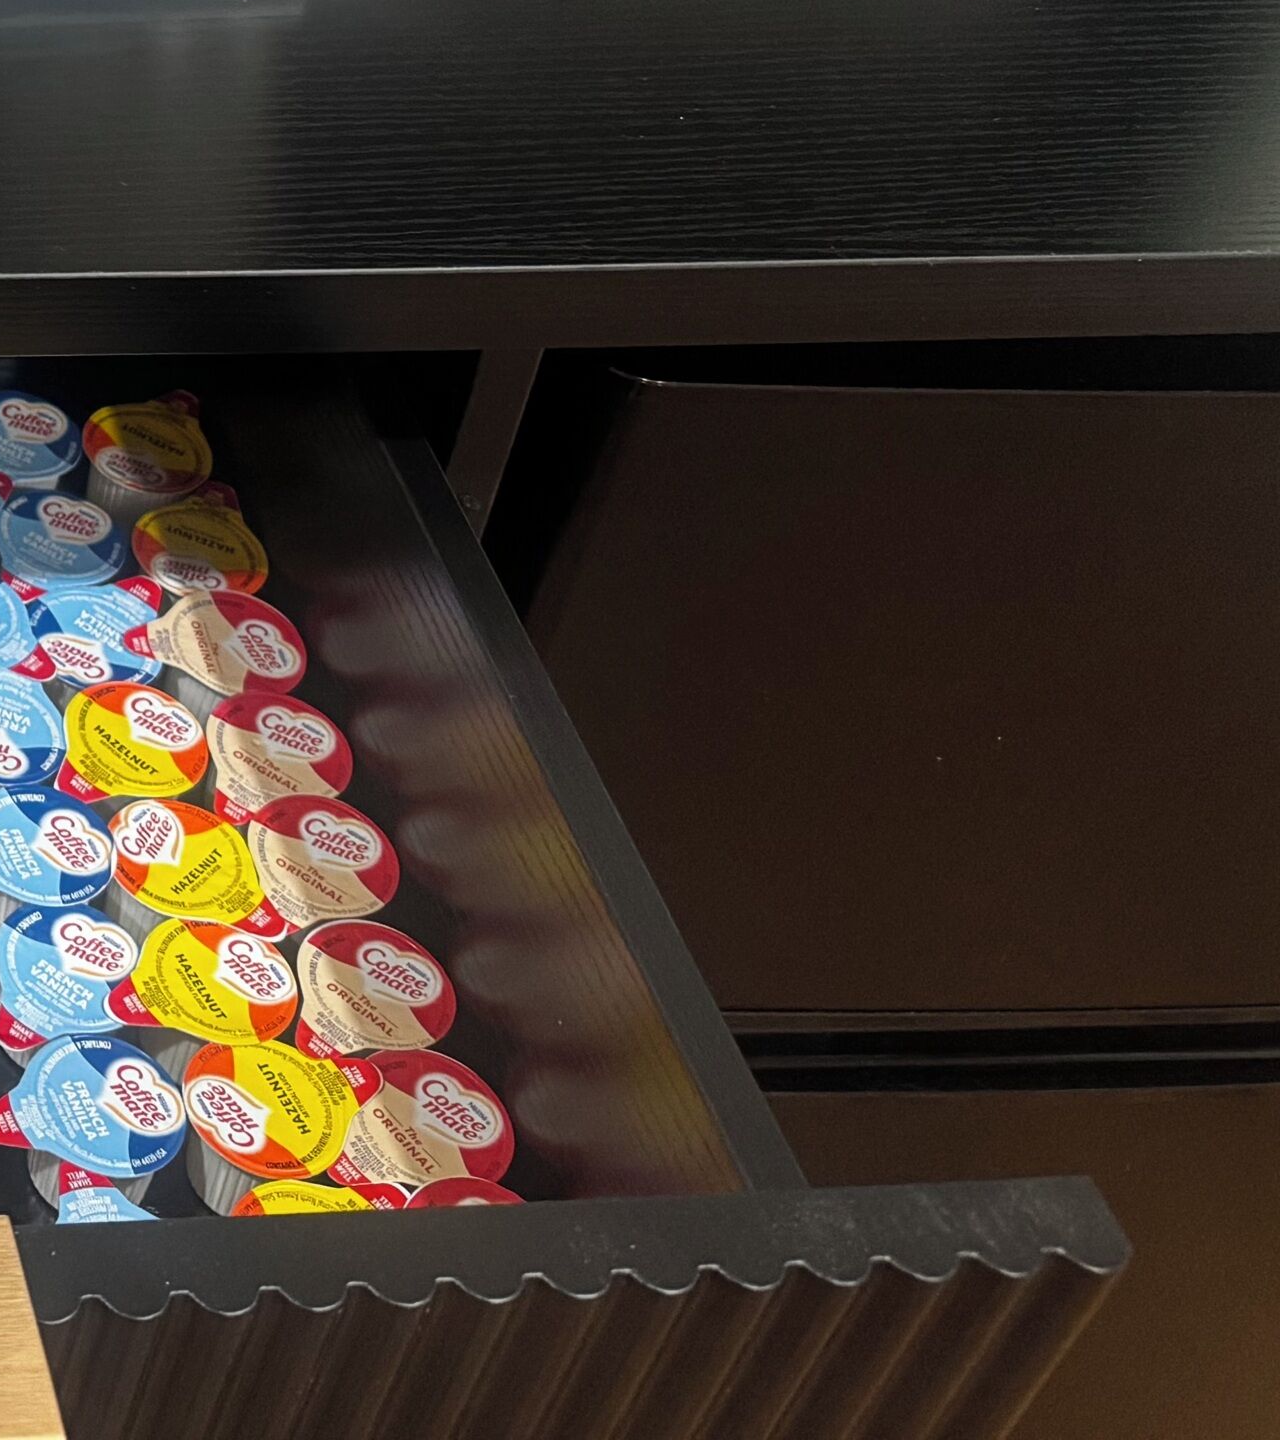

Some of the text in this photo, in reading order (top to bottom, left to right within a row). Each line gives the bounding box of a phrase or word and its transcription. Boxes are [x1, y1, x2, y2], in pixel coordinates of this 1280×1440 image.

[43, 502, 99, 528] Coffee
[49, 519, 96, 537] mate
[48, 648, 105, 679] Coffee
[52, 640, 100, 664] mate
[238, 635, 269, 672] mate
[245, 624, 281, 669] Coffee
[131, 697, 189, 734] Coffee
[134, 716, 184, 744] mate
[261, 712, 323, 746] Coffee
[93, 724, 158, 775] HAZELNUT
[268, 731, 320, 756] mate
[233, 750, 299, 792] ORIGINAL
[263, 758, 281, 772] The
[9, 829, 42, 876] FRENCH
[44, 832, 83, 869] mate
[51, 816, 95, 865] Coffee
[122, 811, 160, 856] Coffee
[145, 820, 173, 859] mate
[304, 818, 369, 853] Coffee
[311, 837, 365, 863] mate
[170, 848, 223, 895] HAZELNUT
[276, 858, 344, 905] ORIGINAL
[307, 865, 325, 881] The
[60, 922, 125, 961] Coffee
[64, 944, 120, 971] mate
[37, 959, 95, 1000] FRENCH
[224, 958, 271, 997] mate
[228, 939, 282, 991] Coffee
[363, 948, 428, 990] Coffee
[367, 967, 422, 999] mate
[30, 965, 88, 1010] VANILLA
[175, 953, 227, 1020] HAZELNUT
[359, 994, 378, 1010] The
[327, 982, 393, 1037] ORIGINAL
[9, 1028, 28, 1043] WELL
[12, 1021, 34, 1040] SHAKE
[308, 1042, 326, 1058] WELL
[310, 1035, 333, 1054] SHAKE
[61, 1081, 98, 1141] VANILLA
[73, 1081, 110, 1137] FRENCH
[110, 1084, 154, 1127] mate
[117, 1064, 167, 1122] Coffee
[212, 1084, 258, 1130] mate
[257, 1063, 311, 1135] HAZELNUT
[422, 1079, 487, 1132] Coffee
[202, 1090, 255, 1147] Coffee
[404, 1126, 423, 1147] The
[422, 1100, 478, 1141] mate
[373, 1108, 434, 1175] ORIGINAL
[335, 1163, 352, 1183] WELL
[340, 1157, 361, 1182] SHAKE
